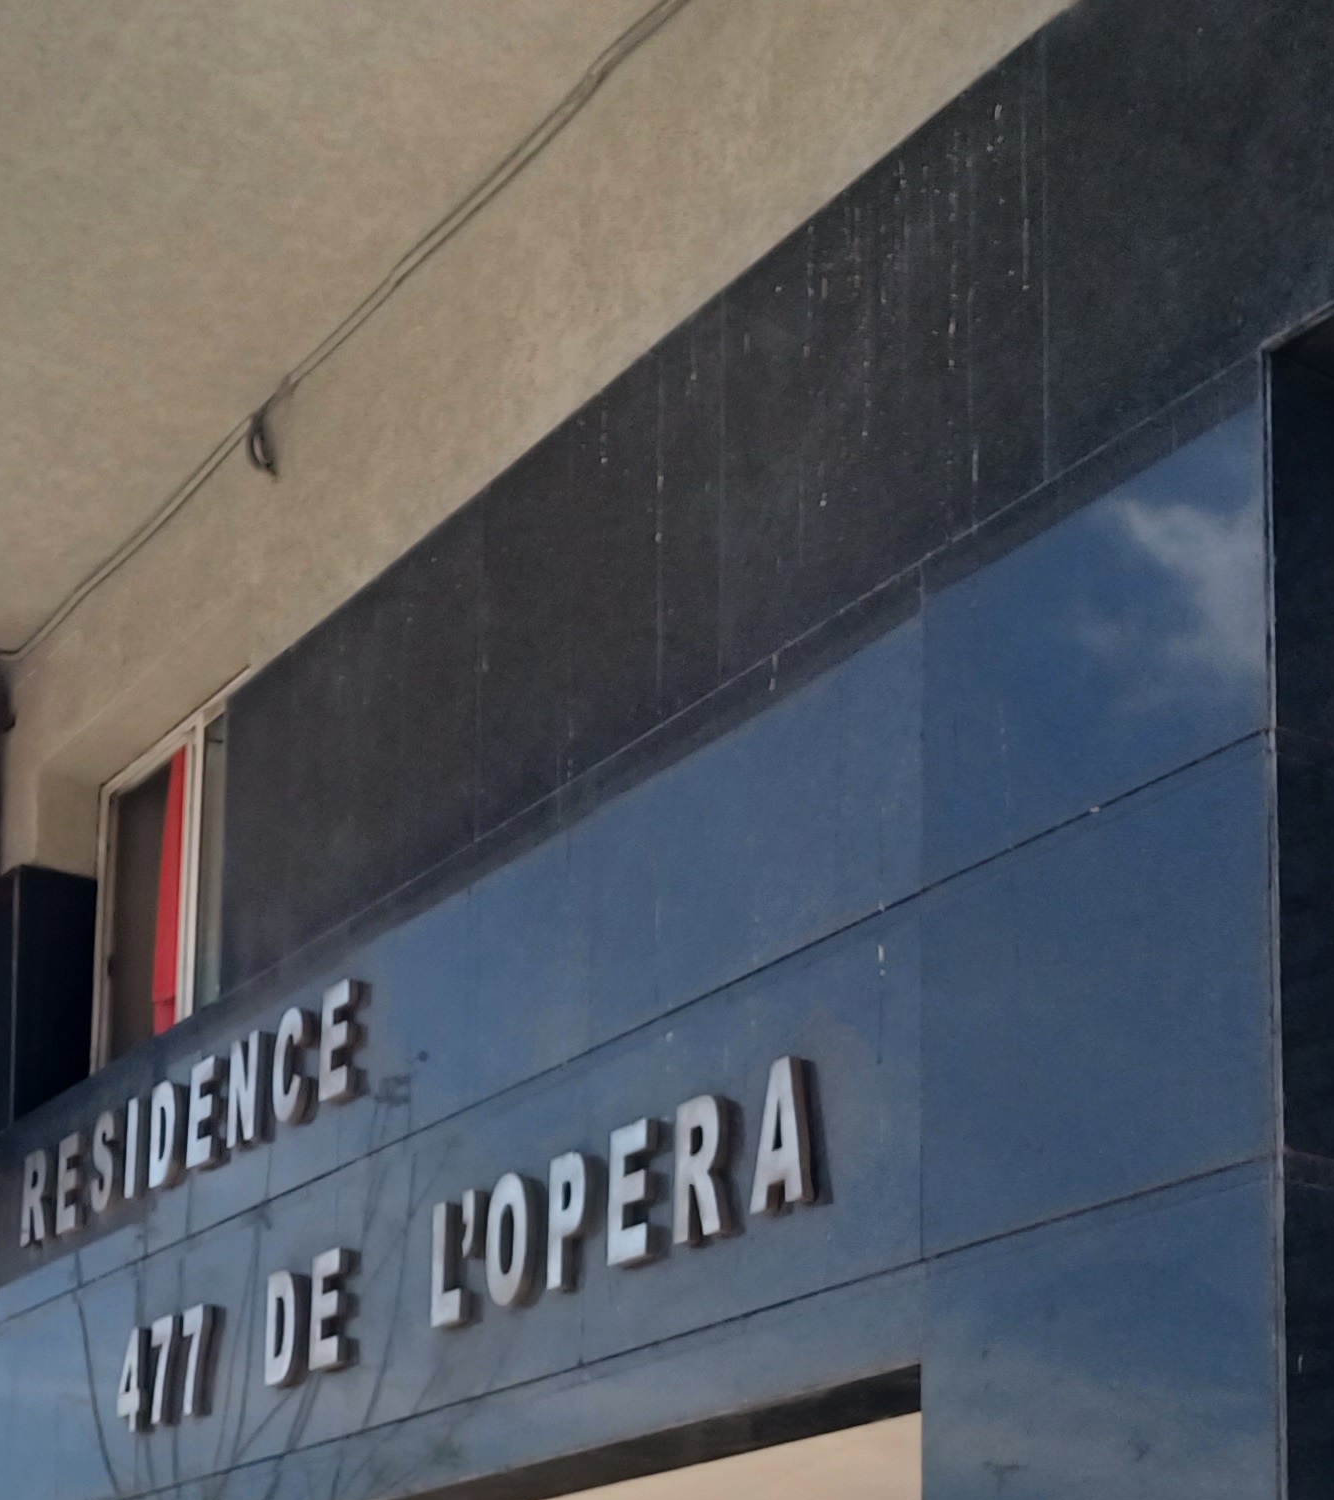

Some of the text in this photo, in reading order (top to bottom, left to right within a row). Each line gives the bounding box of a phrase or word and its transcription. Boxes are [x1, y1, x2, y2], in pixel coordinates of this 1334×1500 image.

[20, 978, 367, 1249] RESIDENCE
[118, 1054, 817, 1432] 477 DE L'OPERA
